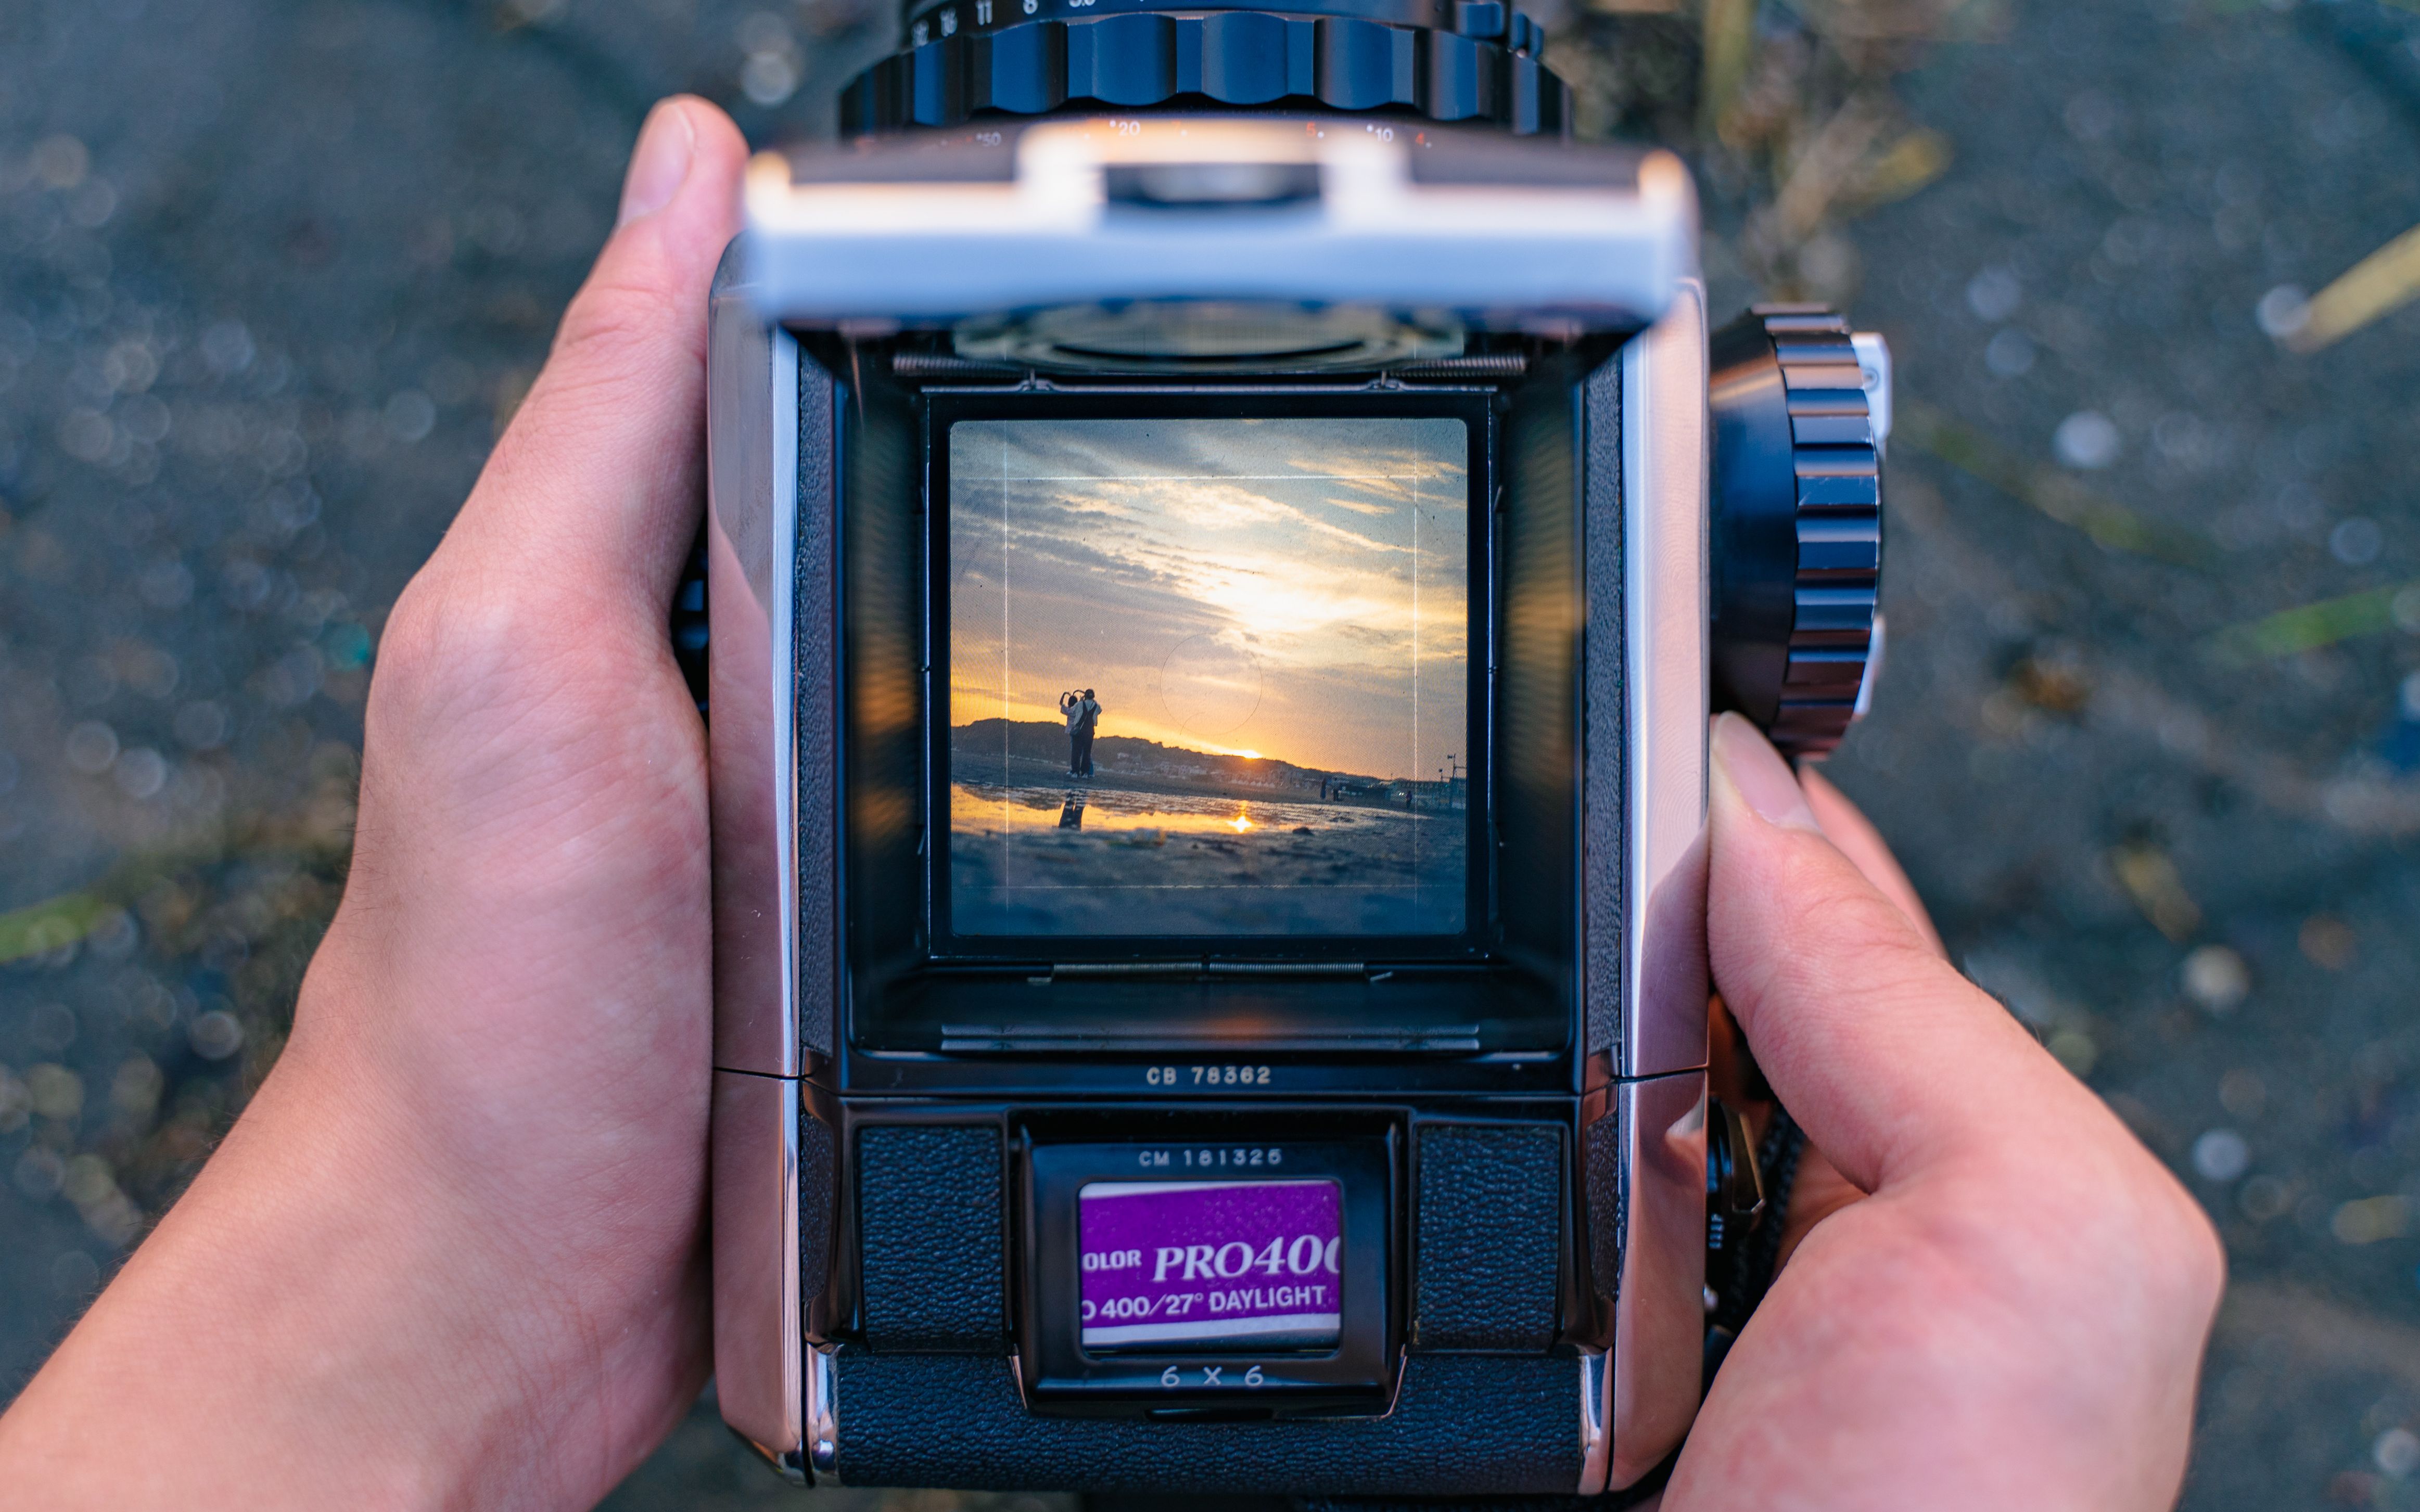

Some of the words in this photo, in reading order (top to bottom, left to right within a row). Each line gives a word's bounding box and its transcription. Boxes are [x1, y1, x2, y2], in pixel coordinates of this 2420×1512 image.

[939, 7, 958, 36] 16
[975, 0, 993, 25] 11
[1118, 121, 1141, 136] 20
[1375, 127, 1394, 143] 10
[1305, 121, 1316, 136] 5
[1415, 132, 1425, 145] 4
[1147, 1067, 1177, 1085] CB
[1191, 1066, 1271, 1085] 78362
[1139, 1151, 1170, 1167] CM
[1100, 1292, 1204, 1319] 400/27°
[1208, 1285, 1327, 1312] DAYLIGHT
[1161, 1365, 1180, 1388] 6
[1244, 1365, 1264, 1387] 6
